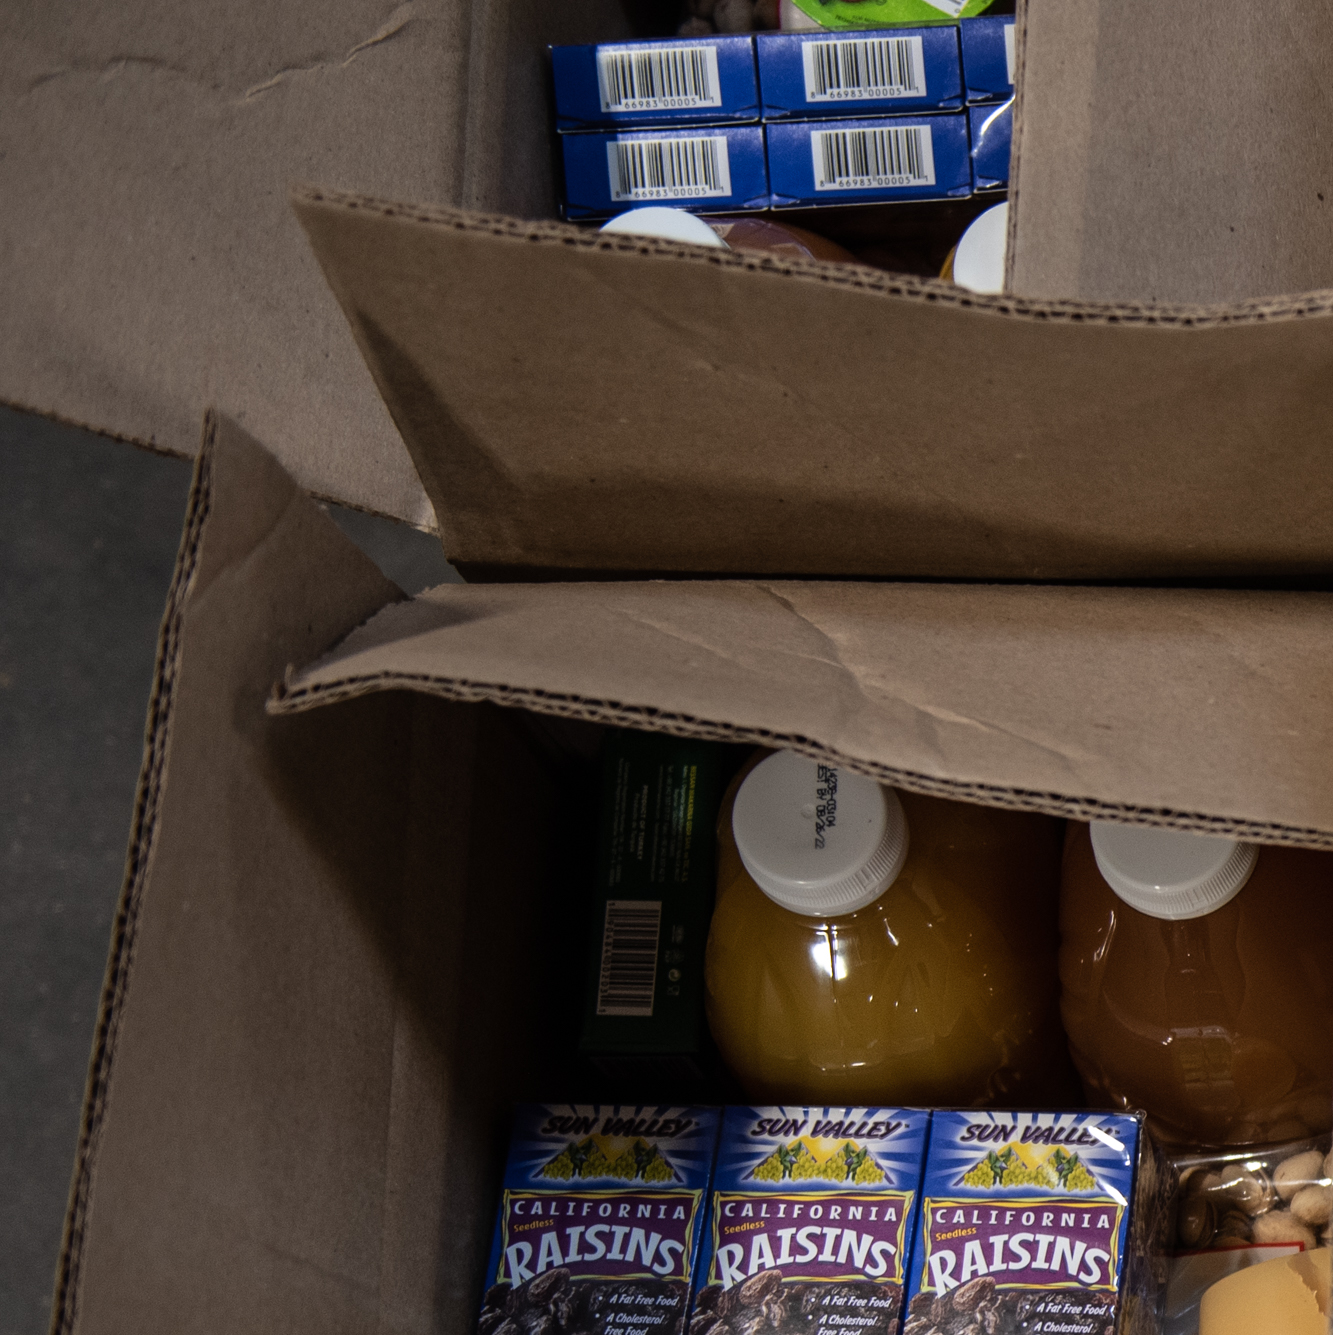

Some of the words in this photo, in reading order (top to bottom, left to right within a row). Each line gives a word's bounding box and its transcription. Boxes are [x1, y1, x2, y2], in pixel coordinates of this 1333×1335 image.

[541, 1115, 600, 1136] SUN
[600, 1116, 693, 1139] VALLEY
[751, 1117, 808, 1138] SUN
[810, 1118, 902, 1140] VALLEY
[959, 1122, 1018, 1144] SUN
[513, 1200, 687, 1221] CALIFORNIA
[724, 1201, 898, 1223] CALIFORNIA
[935, 1208, 1111, 1229] CALIFORNIA
[512, 1218, 556, 1233] Seedless
[723, 1219, 766, 1236] Seedless
[934, 1225, 978, 1242] Seedless
[506, 1223, 686, 1290] RAISINS
[716, 1224, 898, 1292] RAISINS
[928, 1231, 1111, 1299] RAISINS
[831, 1295, 849, 1308] Fat
[848, 1296, 870, 1308] Free
[1046, 1302, 1062, 1314] Fat
[1084, 1304, 1107, 1316] Food
[615, 1312, 664, 1326] Cholesterol
[828, 1314, 878, 1328] Cholesterol
[1043, 1321, 1092, 1334] Cholesterol
